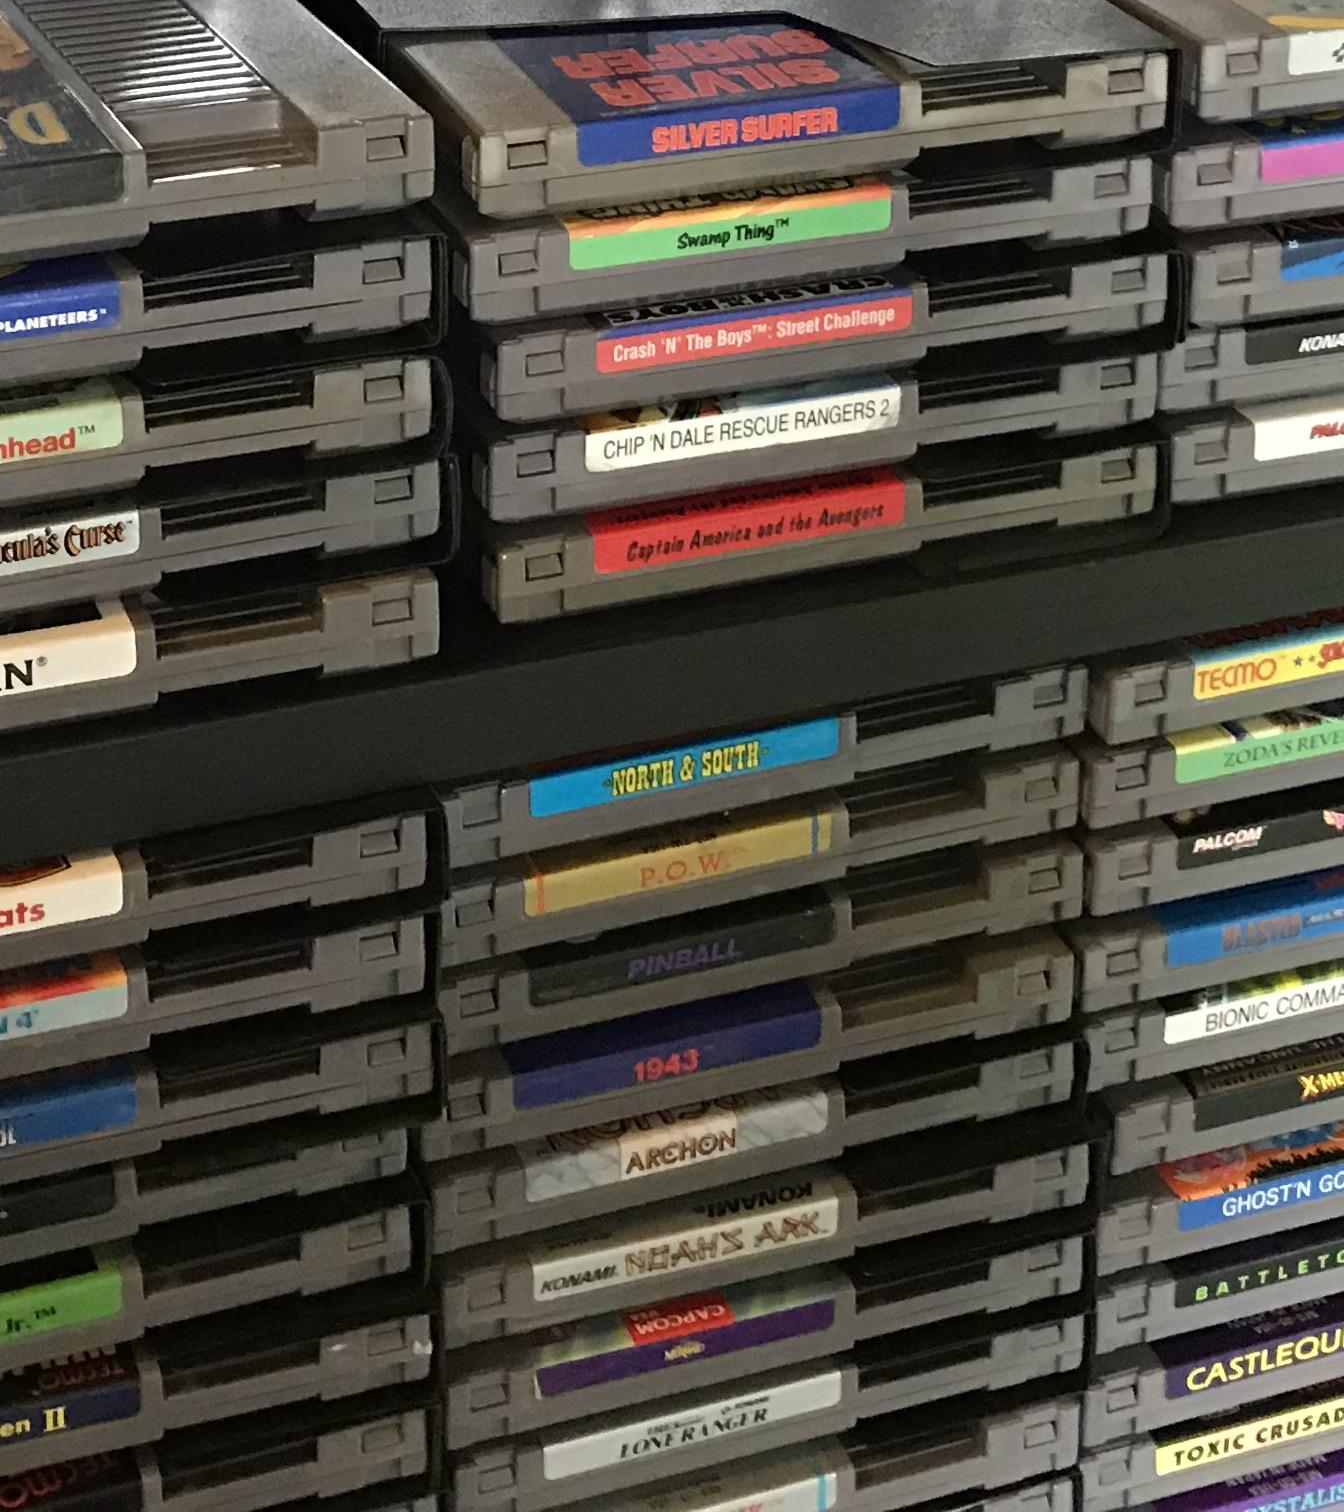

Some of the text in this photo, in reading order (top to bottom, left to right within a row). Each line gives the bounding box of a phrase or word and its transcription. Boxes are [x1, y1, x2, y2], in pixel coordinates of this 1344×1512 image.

[652, 106, 838, 153] SILVER SURFER
[677, 223, 775, 251] Swamp Thing
[613, 340, 655, 363] Crash
[685, 331, 713, 351] The
[776, 318, 819, 339] Street
[823, 306, 895, 336] Challenge
[604, 436, 644, 460] CHIP
[670, 425, 714, 450] DALE
[719, 414, 789, 443] RESCUE
[794, 401, 876, 431] RANGERS
[879, 399, 890, 418] 2
[63, 521, 127, 557] Curse
[627, 502, 884, 564] Captain America and the Avengers
[1197, 658, 1278, 689] TECMO
[611, 741, 760, 797] NORTH & SOUTH
[1223, 740, 1294, 769] ZODA'S
[626, 939, 743, 981] PINBALL
[14, 1010, 35, 1035] 4
[1204, 1000, 1270, 1035] BIONIC
[633, 1048, 701, 1083] 1943
[625, 1128, 737, 1175] ARCHON
[634, 1304, 728, 1337] CAPCOM
[42, 1404, 68, 1434] II
[1173, 1433, 1245, 1467] TOXIC
